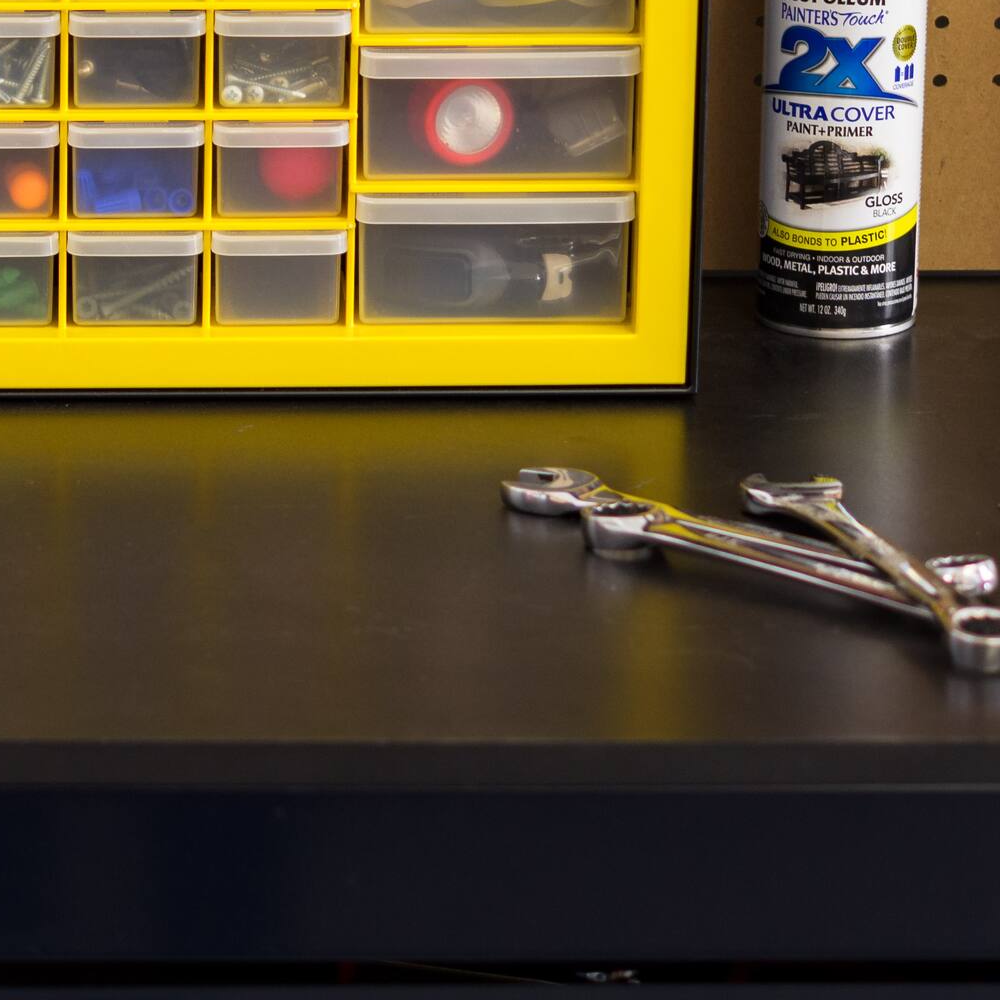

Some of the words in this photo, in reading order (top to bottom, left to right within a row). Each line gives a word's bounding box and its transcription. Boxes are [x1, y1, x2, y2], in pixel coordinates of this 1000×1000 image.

[781, 2, 838, 26] PAINTER'S
[838, 9, 885, 27] Touch
[779, 25, 886, 95] 2X
[772, 97, 828, 121] ULTRA
[831, 105, 895, 122] COVER
[786, 121, 873, 137] PAINT+PRIMER
[865, 192, 903, 208] GLOSS
[873, 208, 896, 218] BLACK
[772, 227, 790, 240] ALSO
[792, 233, 822, 246] BONDS
[825, 238, 837, 246] TO
[786, 250, 811, 260] DRYING
[817, 255, 844, 263] INDOOR
[852, 254, 885, 263] OUTDOOR
[784, 260, 816, 275] METAL,
[818, 265, 859, 276] PLASTIC
[861, 266, 869, 275] &
[871, 261, 896, 275] MORE
[817, 305, 823, 314] 12
